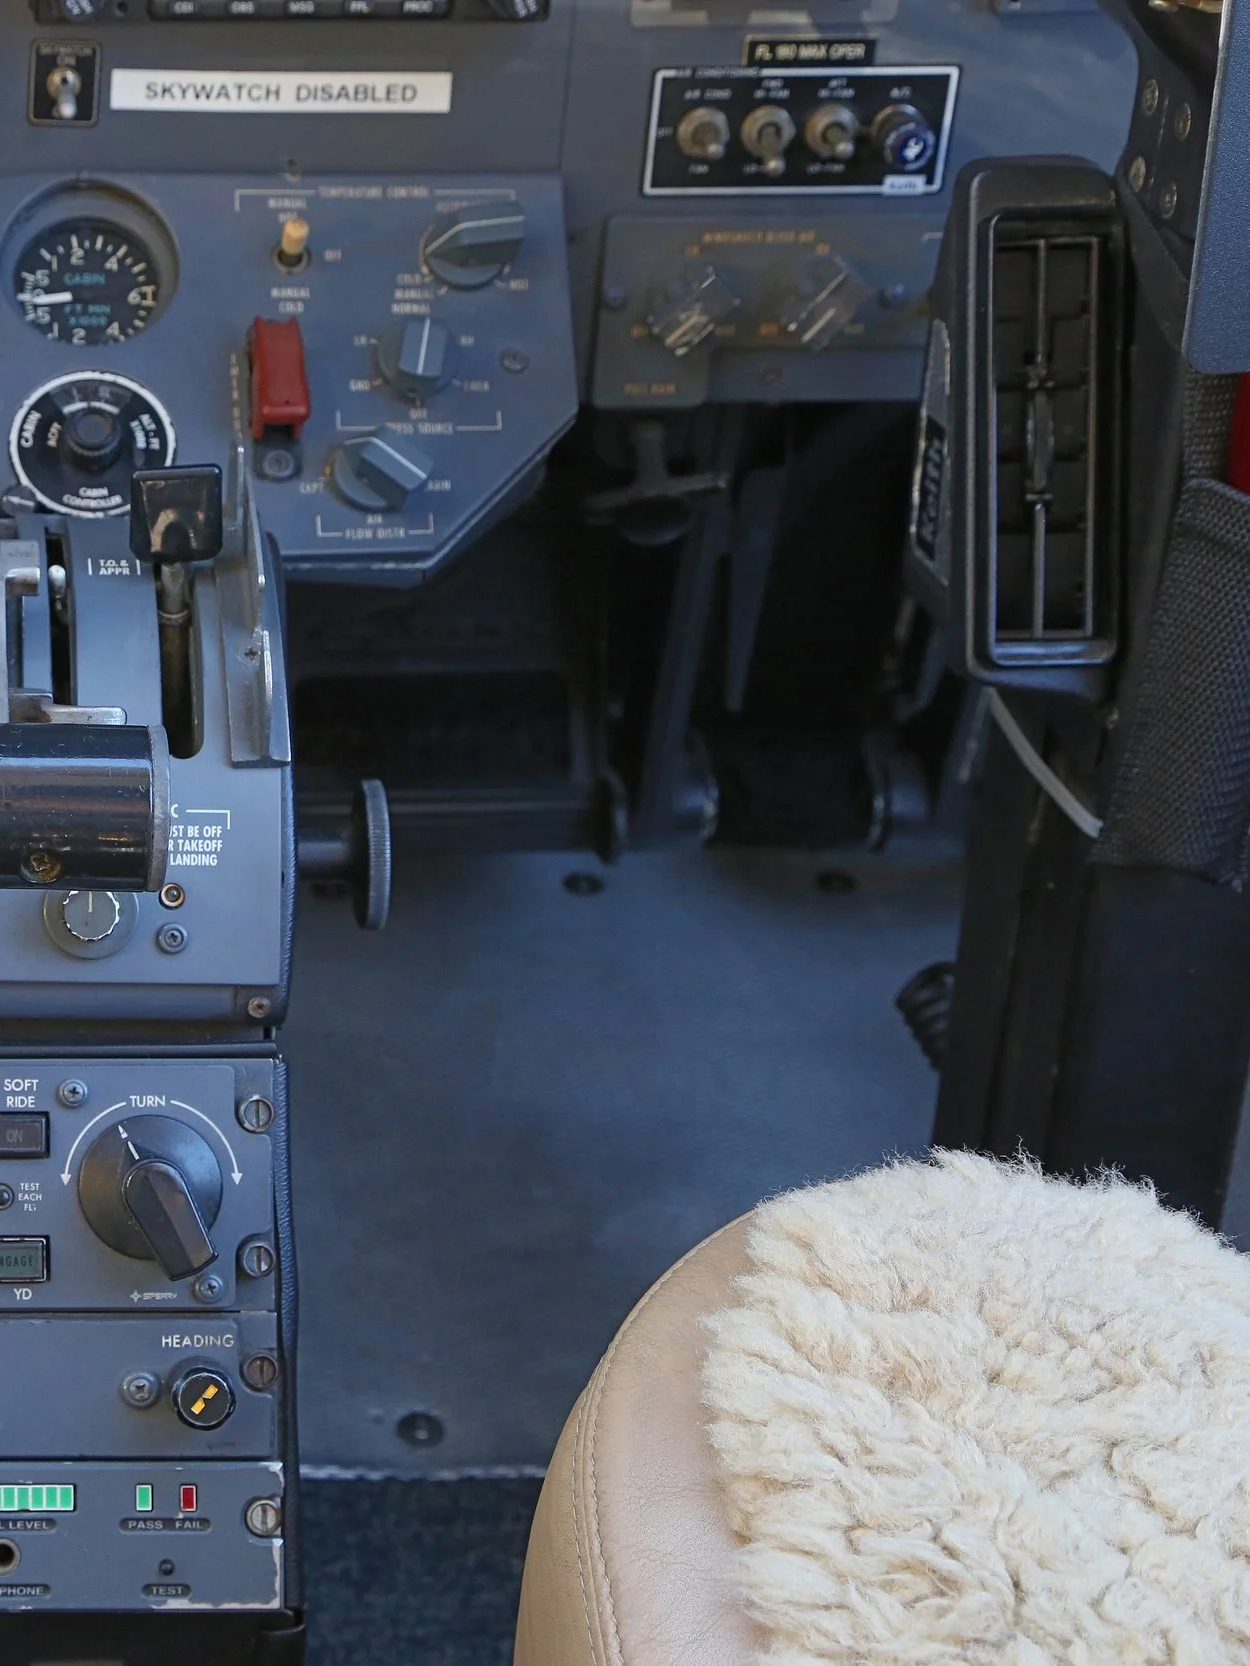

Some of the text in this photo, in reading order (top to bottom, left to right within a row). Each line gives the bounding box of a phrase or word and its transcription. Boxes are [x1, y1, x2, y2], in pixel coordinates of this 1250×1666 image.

[145, 82, 418, 103] SKYWATCH DISABLED
[70, 248, 85, 266] 2
[104, 256, 119, 272] 4
[20, 410, 42, 448] CABIN
[78, 486, 109, 498] CABIN
[99, 567, 130, 576] APPR
[187, 825, 222, 838] BE OFF
[178, 839, 223, 852] TAKEOFF
[170, 853, 218, 866] LANDING
[3, 1078, 39, 1091] SOFT
[6, 1096, 36, 1107] RIDE
[130, 1095, 166, 1107] TURN
[20, 1183, 40, 1191] TEST
[18, 1193, 42, 1201] EACH
[14, 1288, 33, 1300] YD
[142, 1292, 178, 1301] SPERRY
[161, 1334, 235, 1347] HEADING
[8, 1520, 49, 1530] LEVEL
[128, 1520, 203, 1529] PASS FAIL
[151, 1586, 183, 1595] TEST
